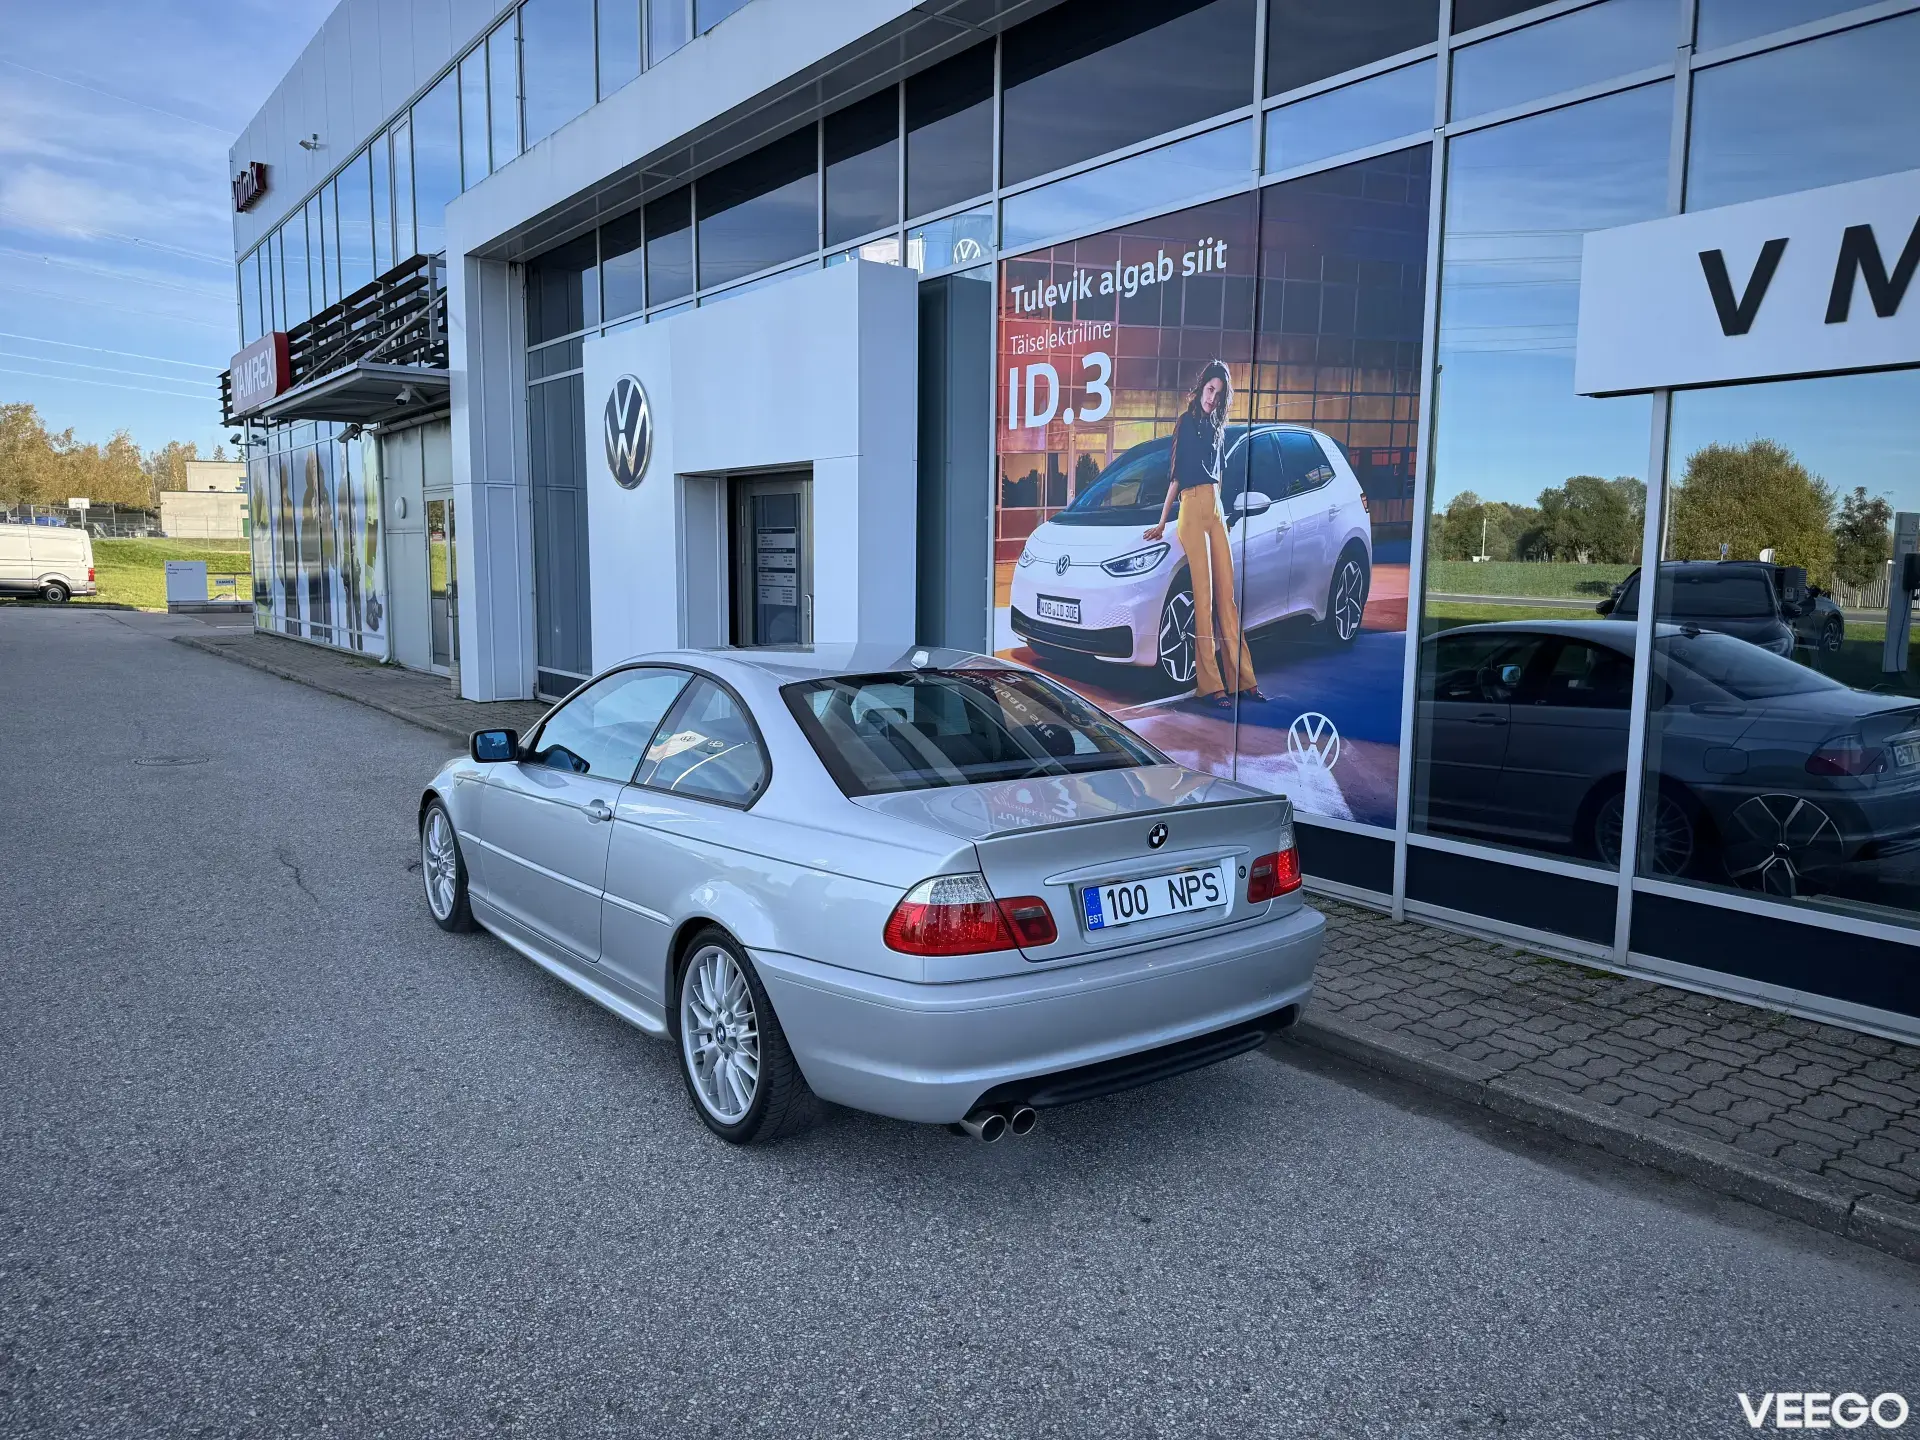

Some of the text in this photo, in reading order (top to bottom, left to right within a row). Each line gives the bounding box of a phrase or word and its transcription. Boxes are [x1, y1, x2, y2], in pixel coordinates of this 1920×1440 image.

[1011, 236, 1228, 314] Tulevik algab siit
[1010, 320, 1112, 356] Täiselektriline
[234, 347, 273, 402] TAMREX
[1008, 351, 1112, 430] ID.3
[604, 374, 653, 490] VW
[1089, 913, 1103, 925] EST
[1107, 872, 1219, 920] 100 NPS
